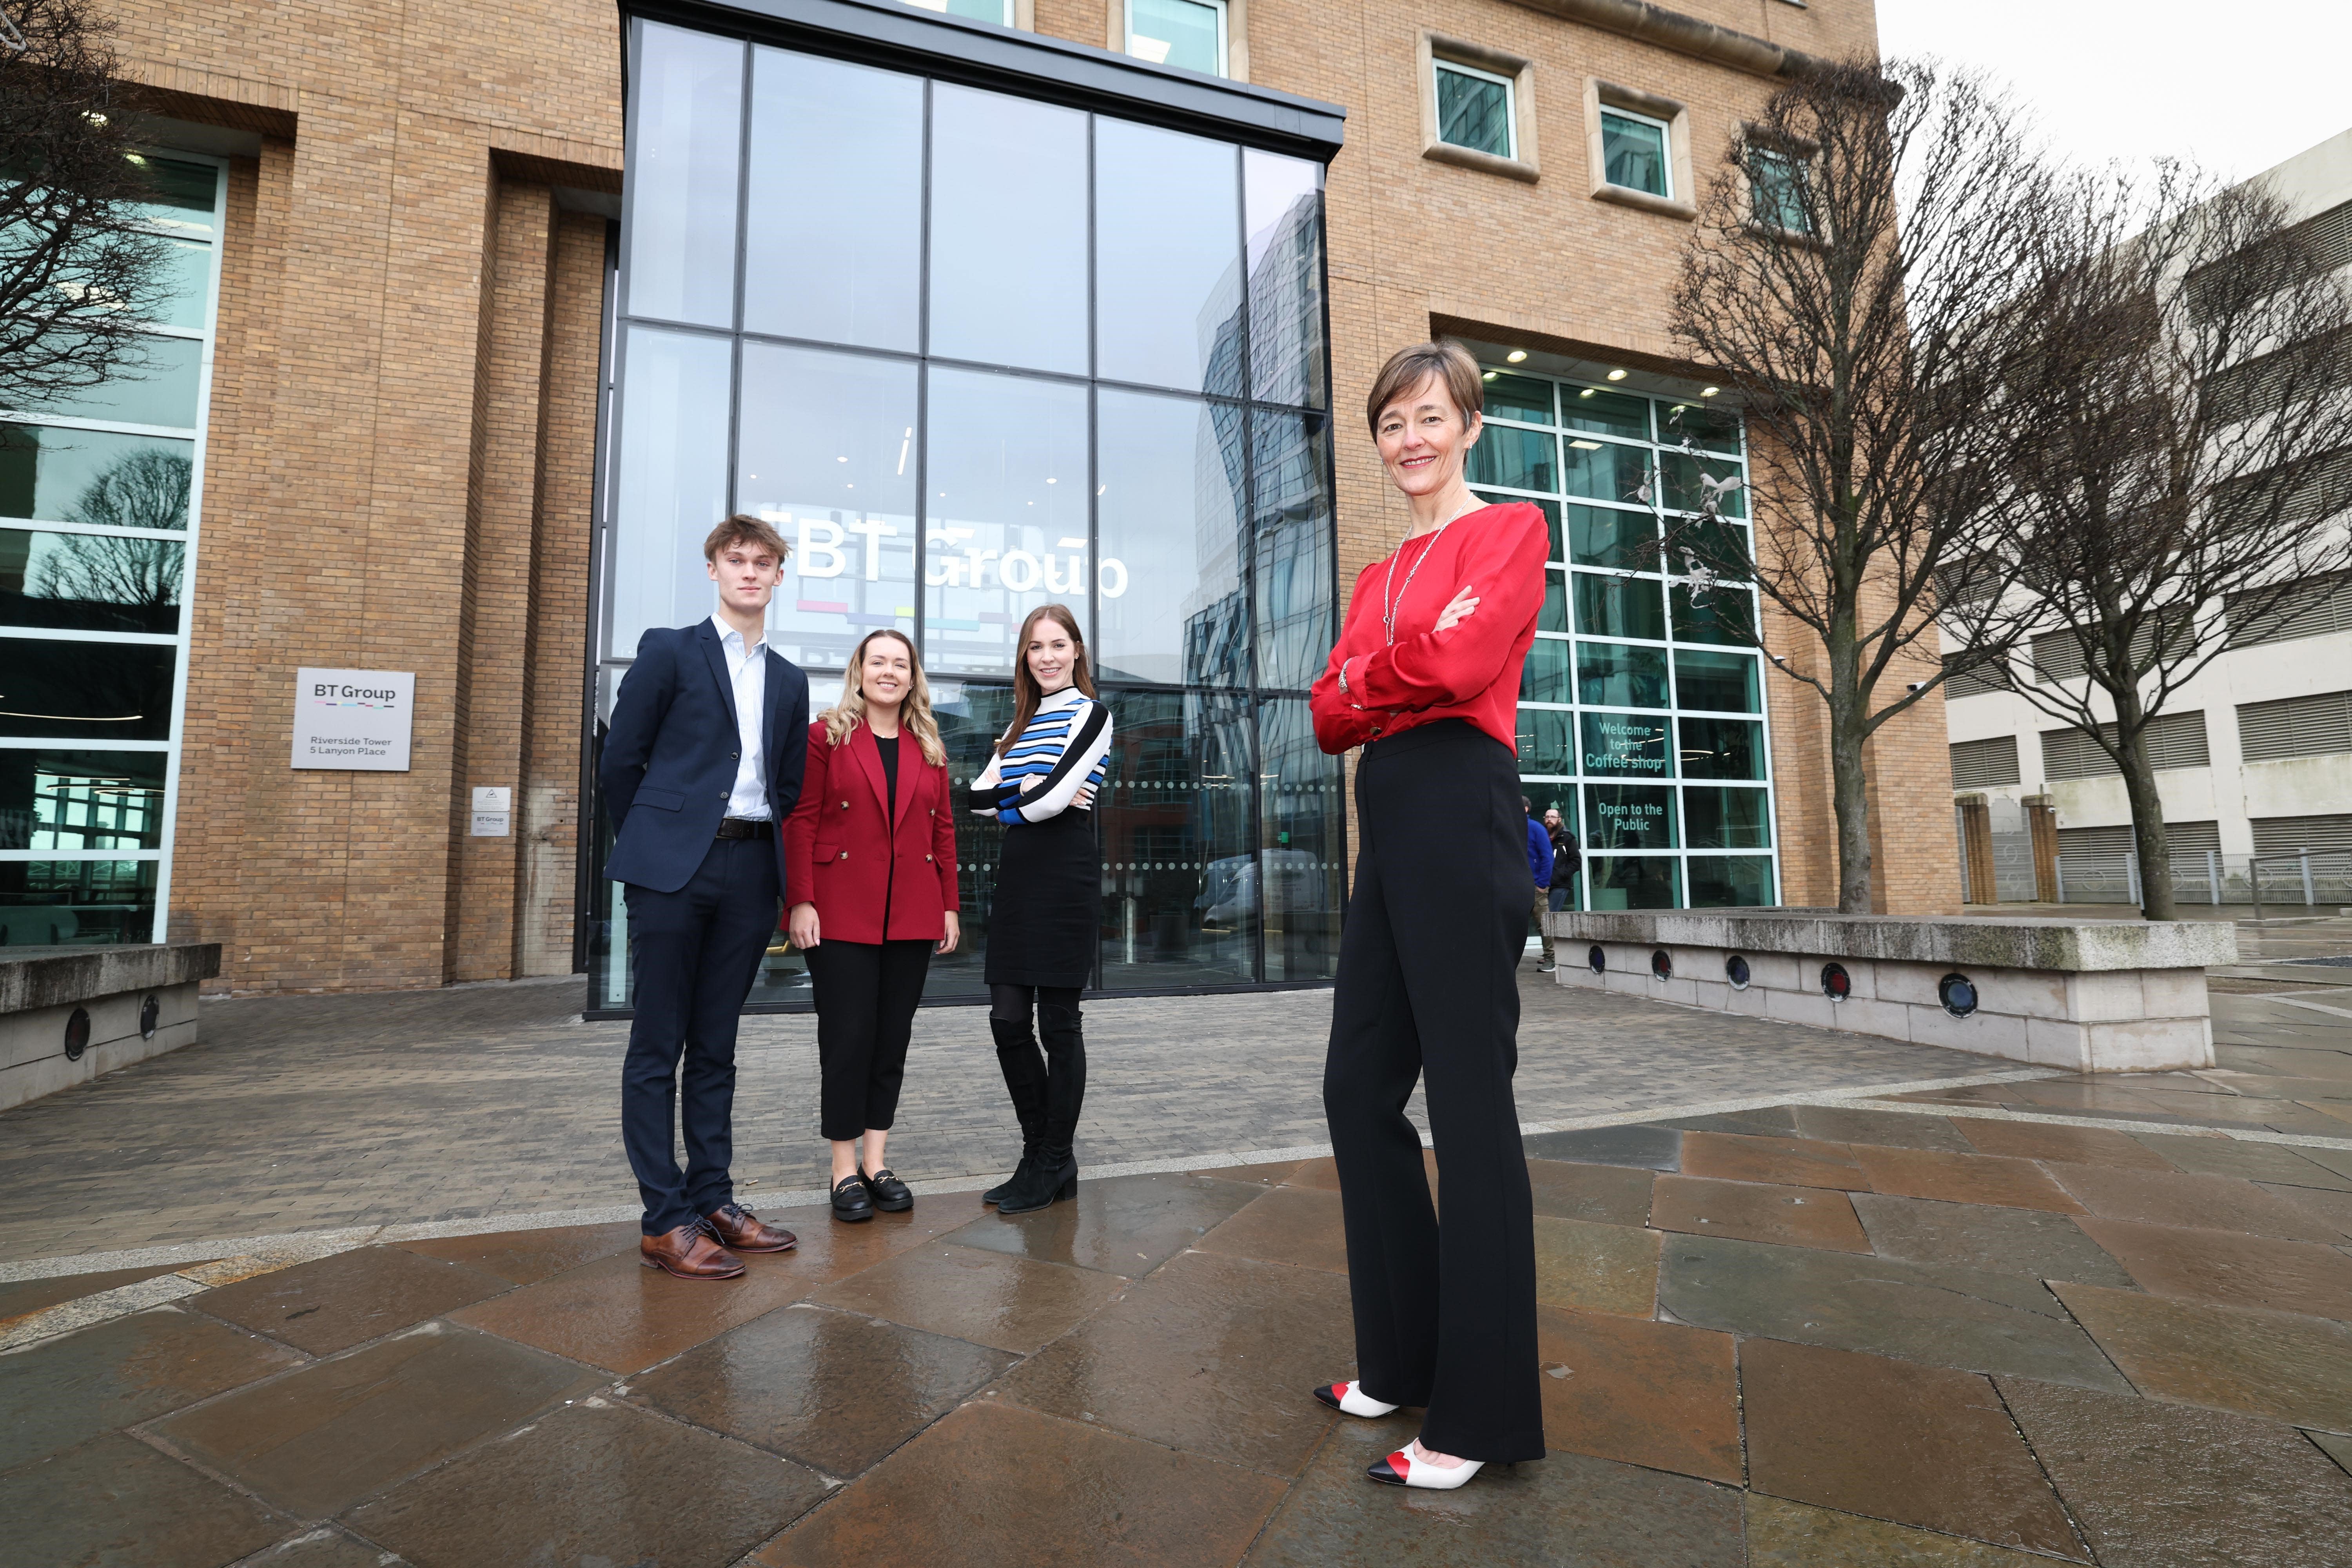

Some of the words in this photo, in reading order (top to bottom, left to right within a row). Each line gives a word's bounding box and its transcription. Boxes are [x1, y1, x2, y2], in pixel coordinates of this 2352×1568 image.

[797, 517, 897, 583] BT
[911, 528, 1128, 611] Group
[314, 684, 339, 697] BT
[341, 685, 396, 702] Group
[1599, 722, 1651, 735] Welcome
[310, 736, 361, 745] Riverside
[1610, 739, 1621, 750] to
[1624, 739, 1642, 751] the
[318, 747, 355, 755] Lanyon
[1586, 753, 1628, 768] Coffee
[1632, 755, 1661, 772] shop
[1598, 802, 1628, 817] Open
[1630, 804, 1642, 815] to
[1645, 803, 1662, 815] the
[1614, 818, 1650, 831] Public
